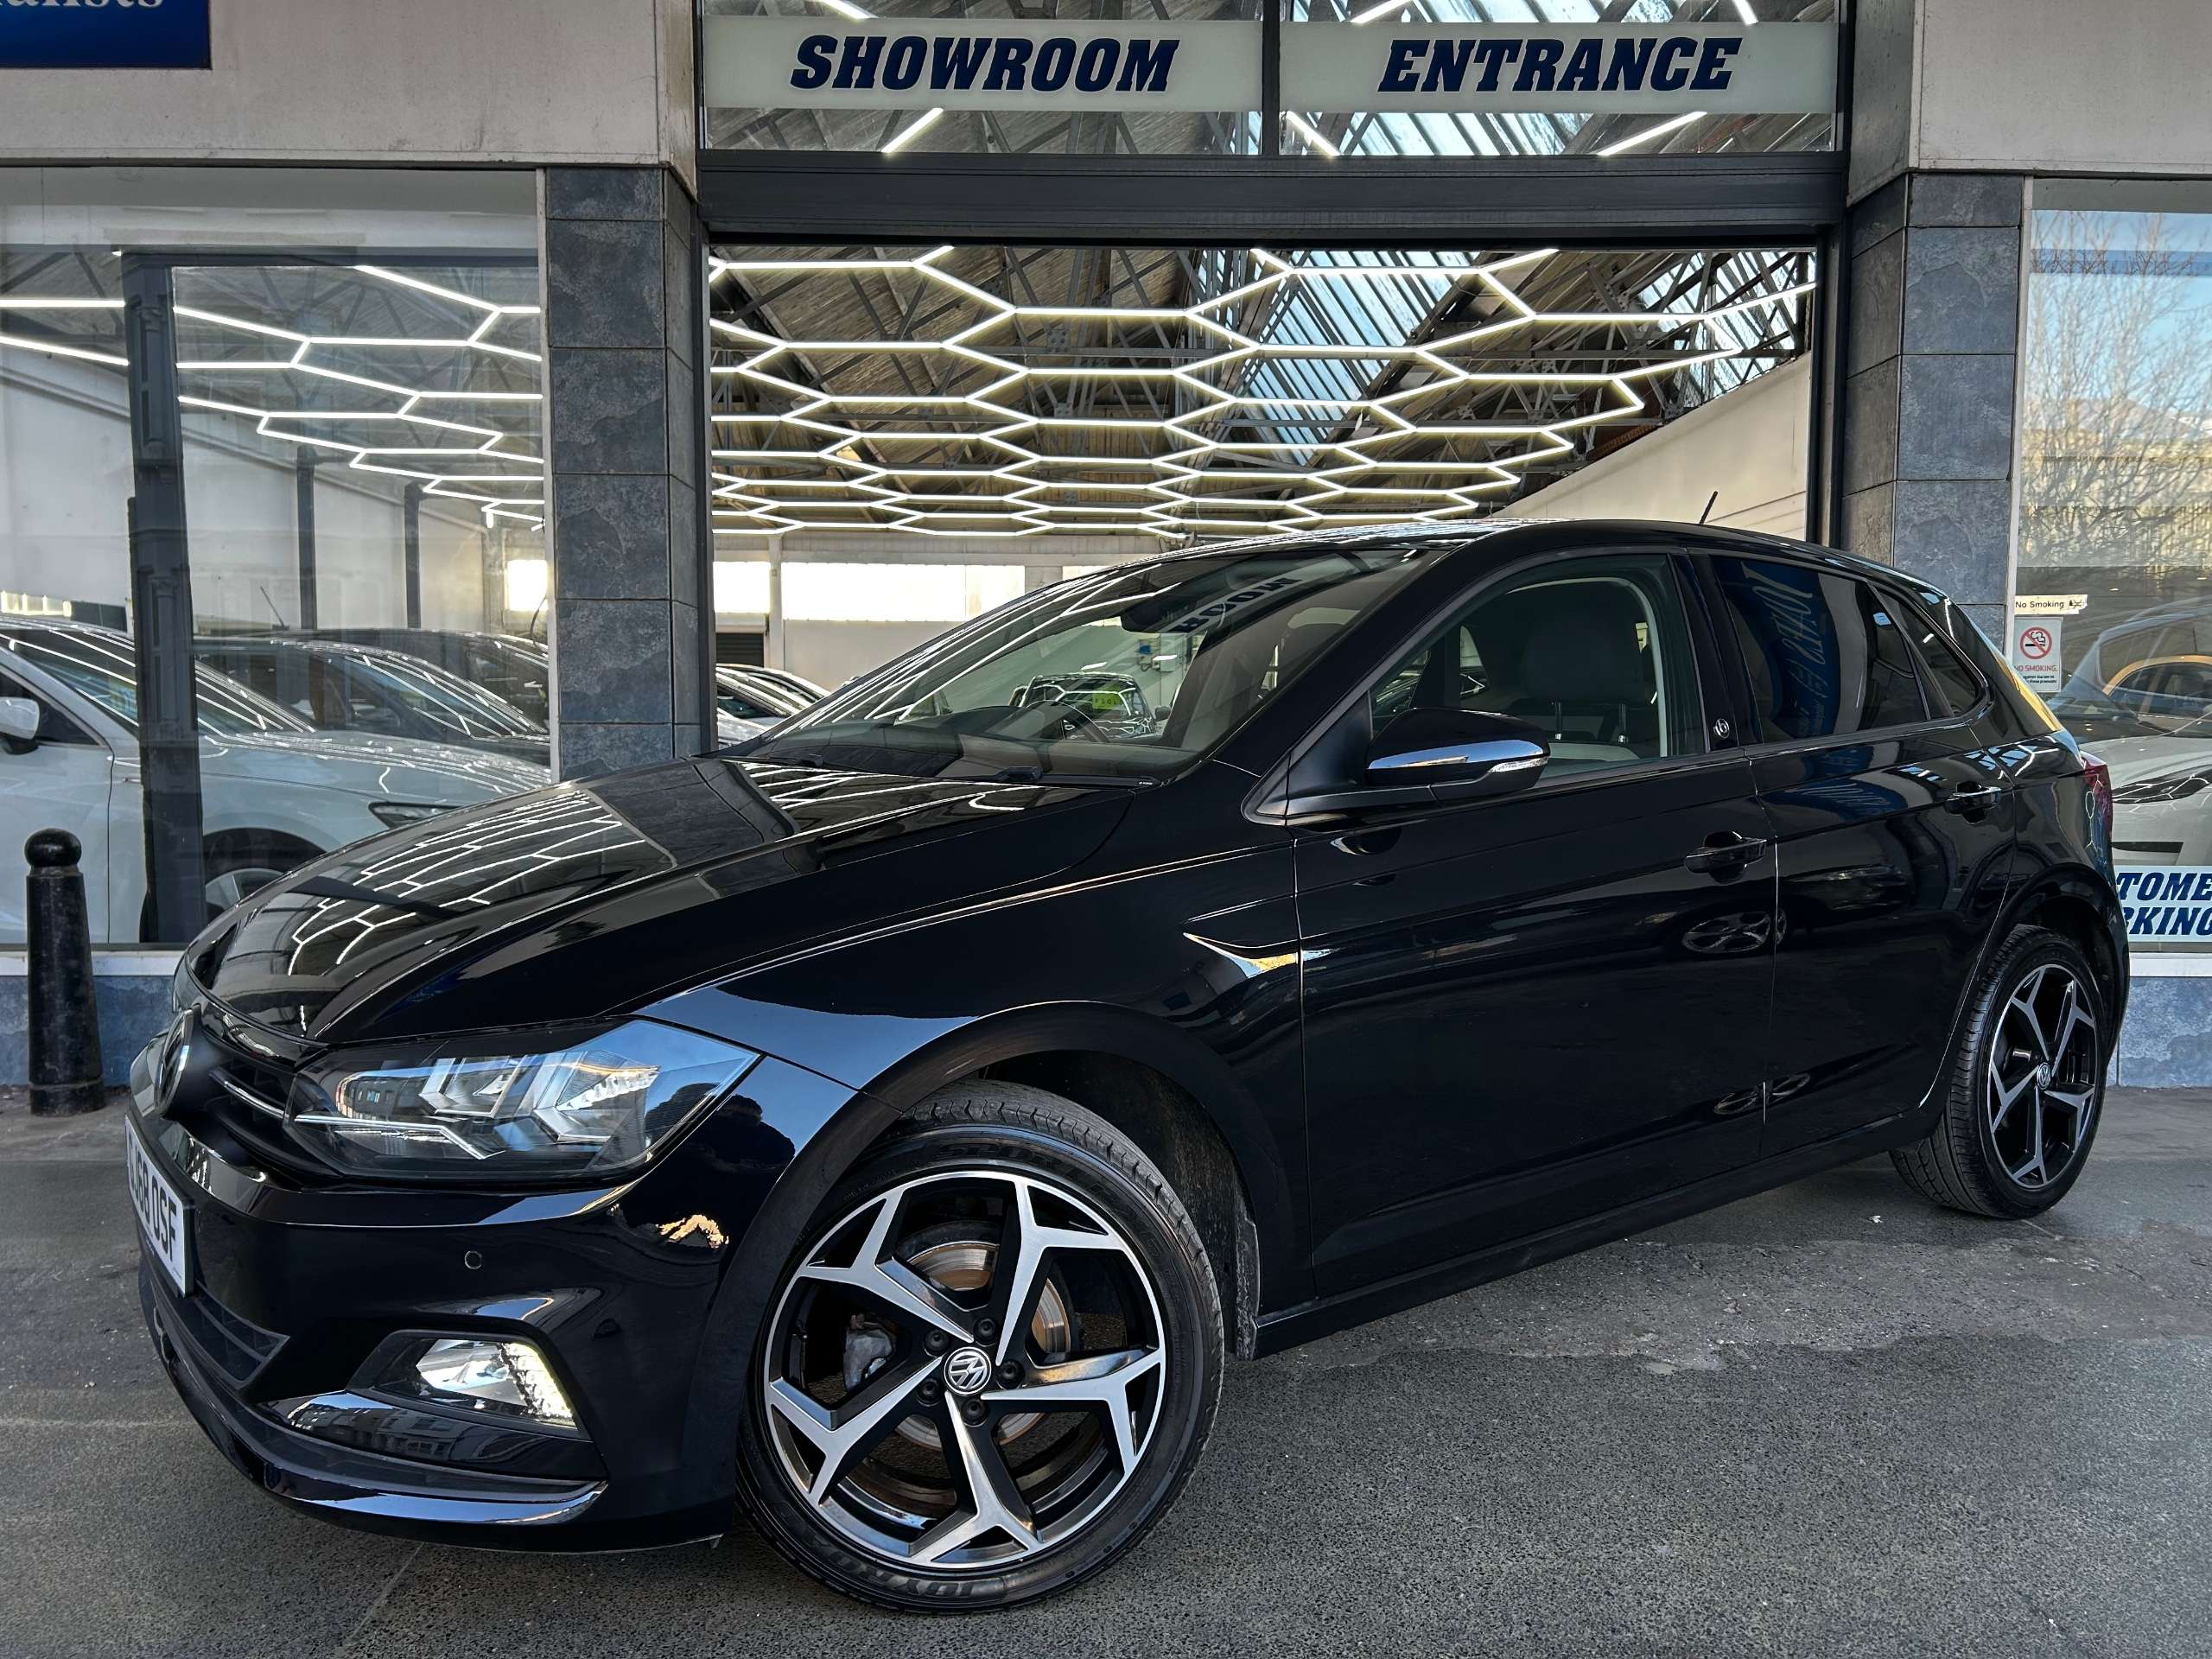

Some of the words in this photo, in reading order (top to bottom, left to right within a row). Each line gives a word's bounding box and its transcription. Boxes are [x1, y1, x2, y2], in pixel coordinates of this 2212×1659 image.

[790, 35, 1180, 92] SHOWROOM
[1377, 36, 1743, 92] ENTRANCE
[2030, 601, 2064, 609] Smoking
[152, 1175, 177, 1262] OSF
